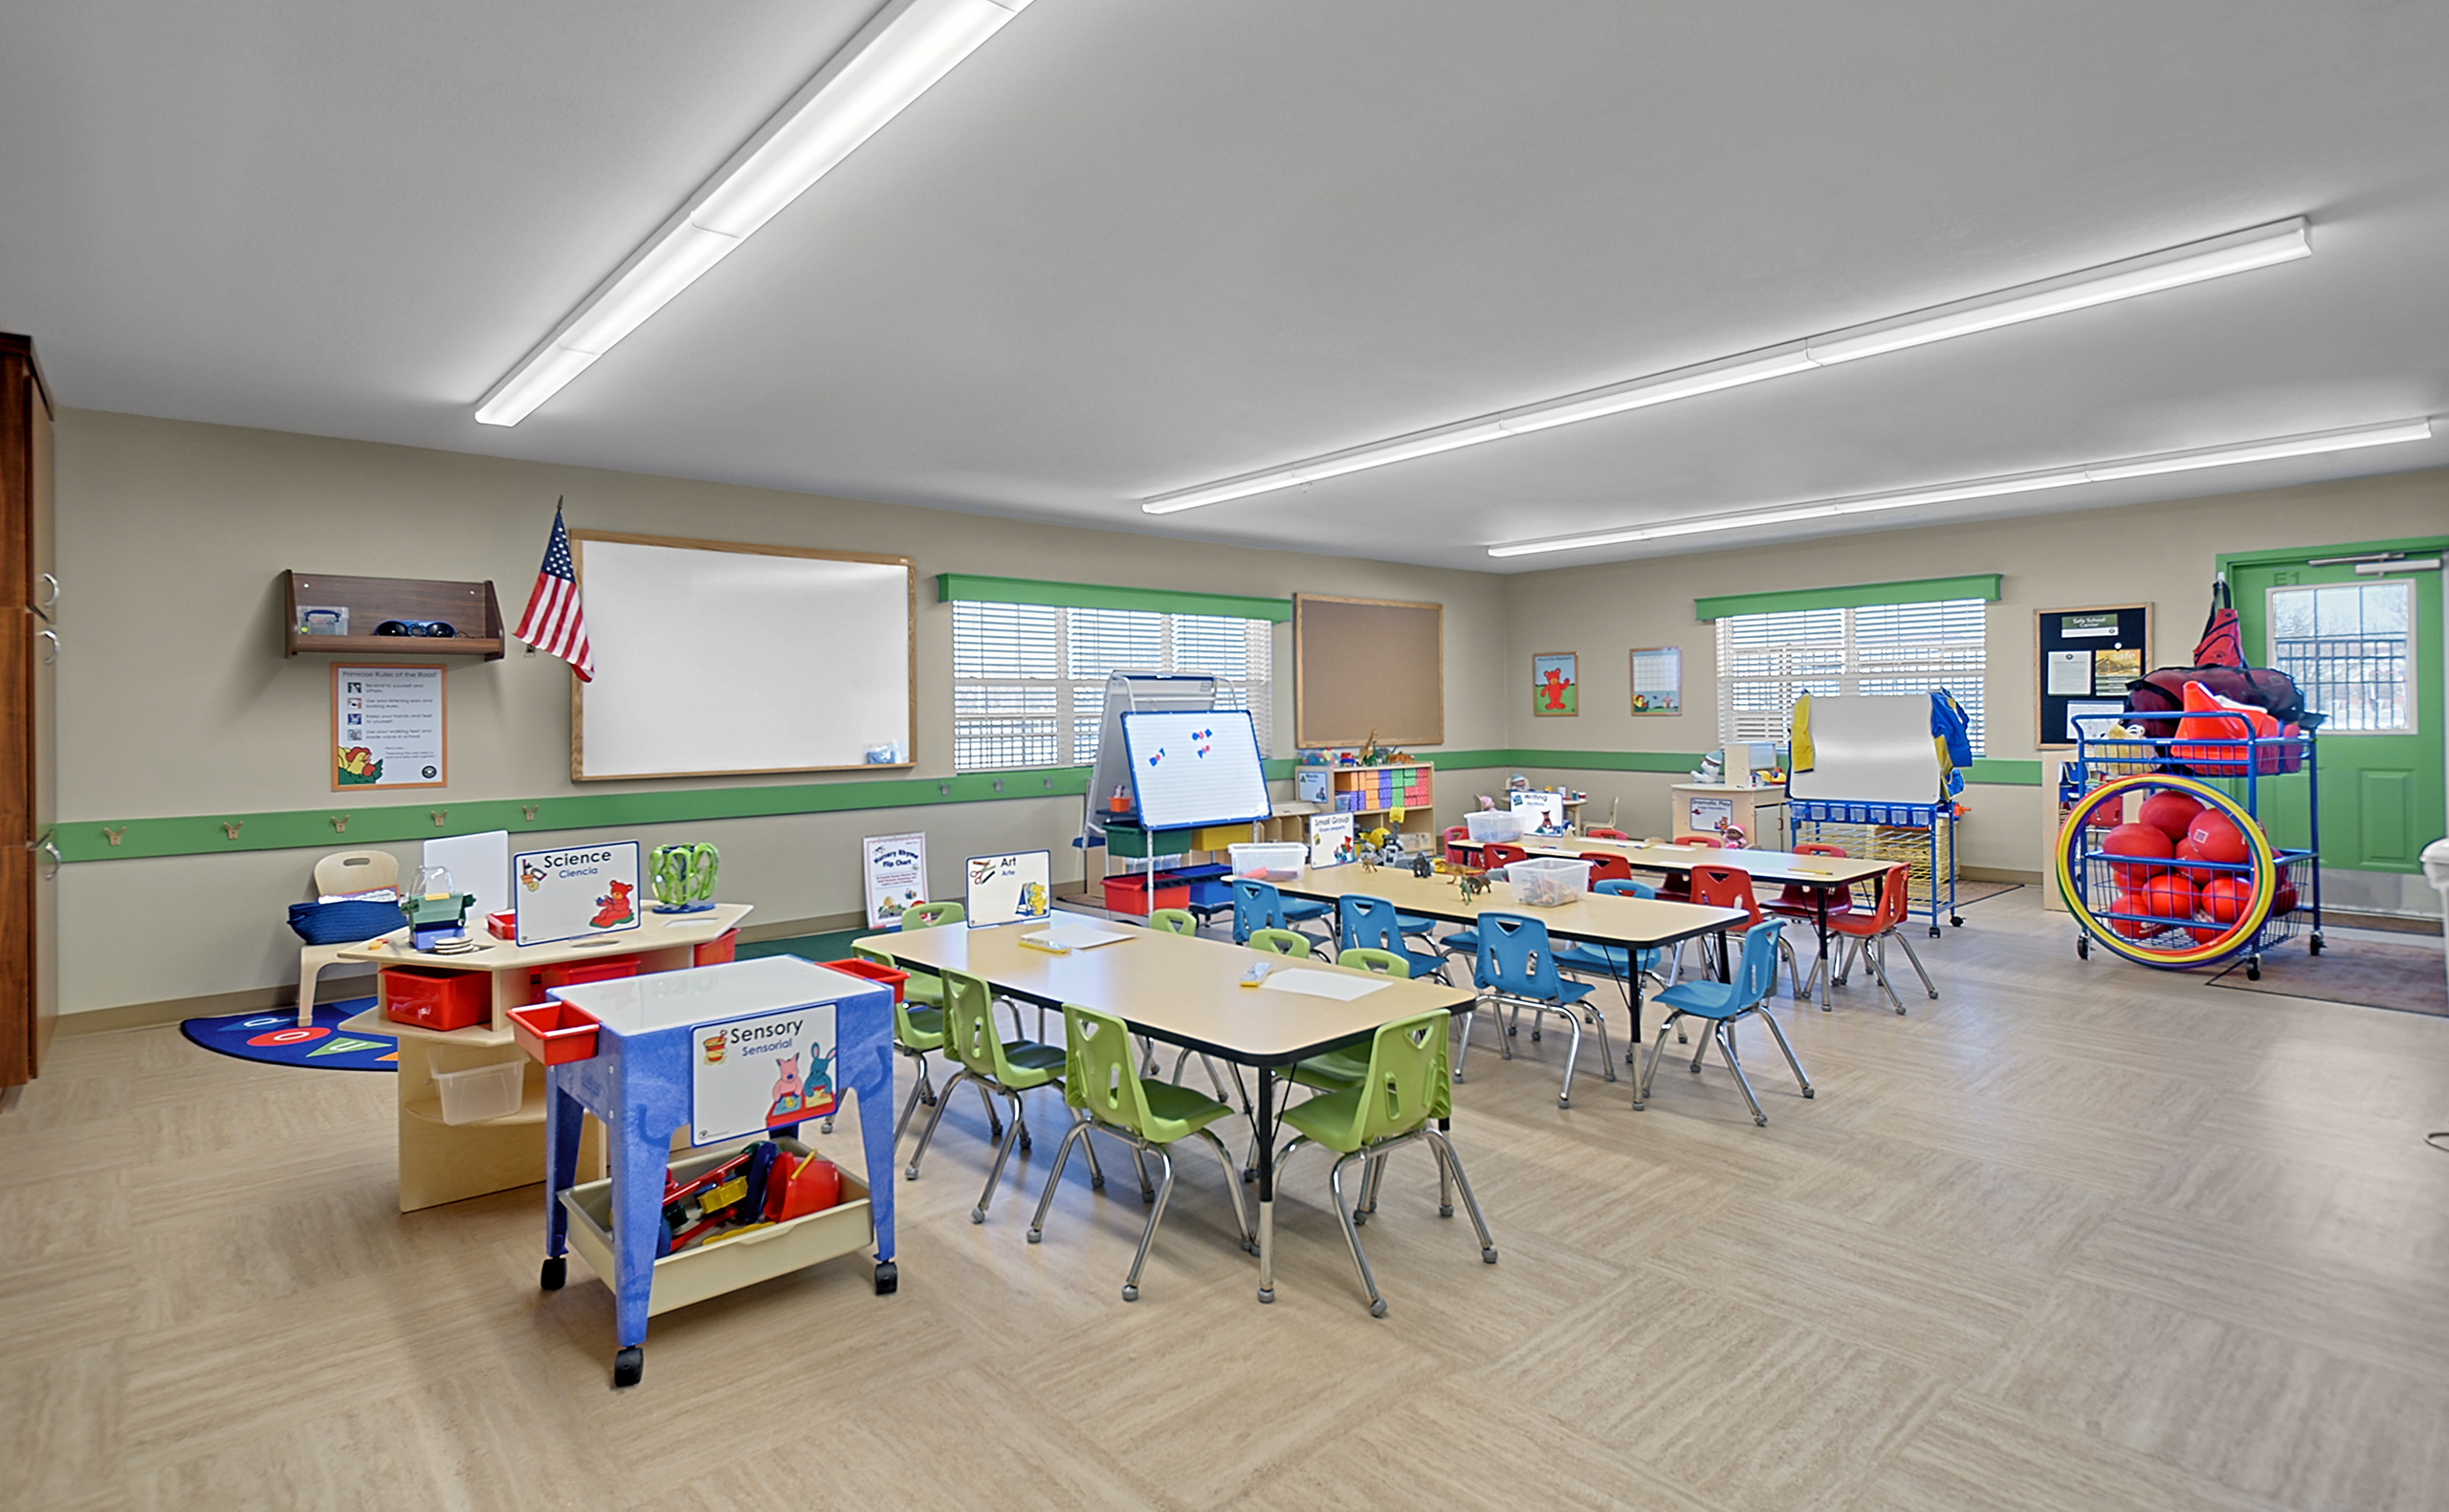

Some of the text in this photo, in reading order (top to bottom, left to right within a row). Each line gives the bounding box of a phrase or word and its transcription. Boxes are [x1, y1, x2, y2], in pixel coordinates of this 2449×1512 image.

[1314, 818, 1330, 826] Small
[544, 851, 611, 868] Science
[898, 849, 918, 859] Rhyme
[1001, 857, 1016, 867] Art
[559, 866, 598, 879] Ciencia
[731, 1019, 805, 1044] Sensory
[741, 1039, 792, 1057] Sensorial
